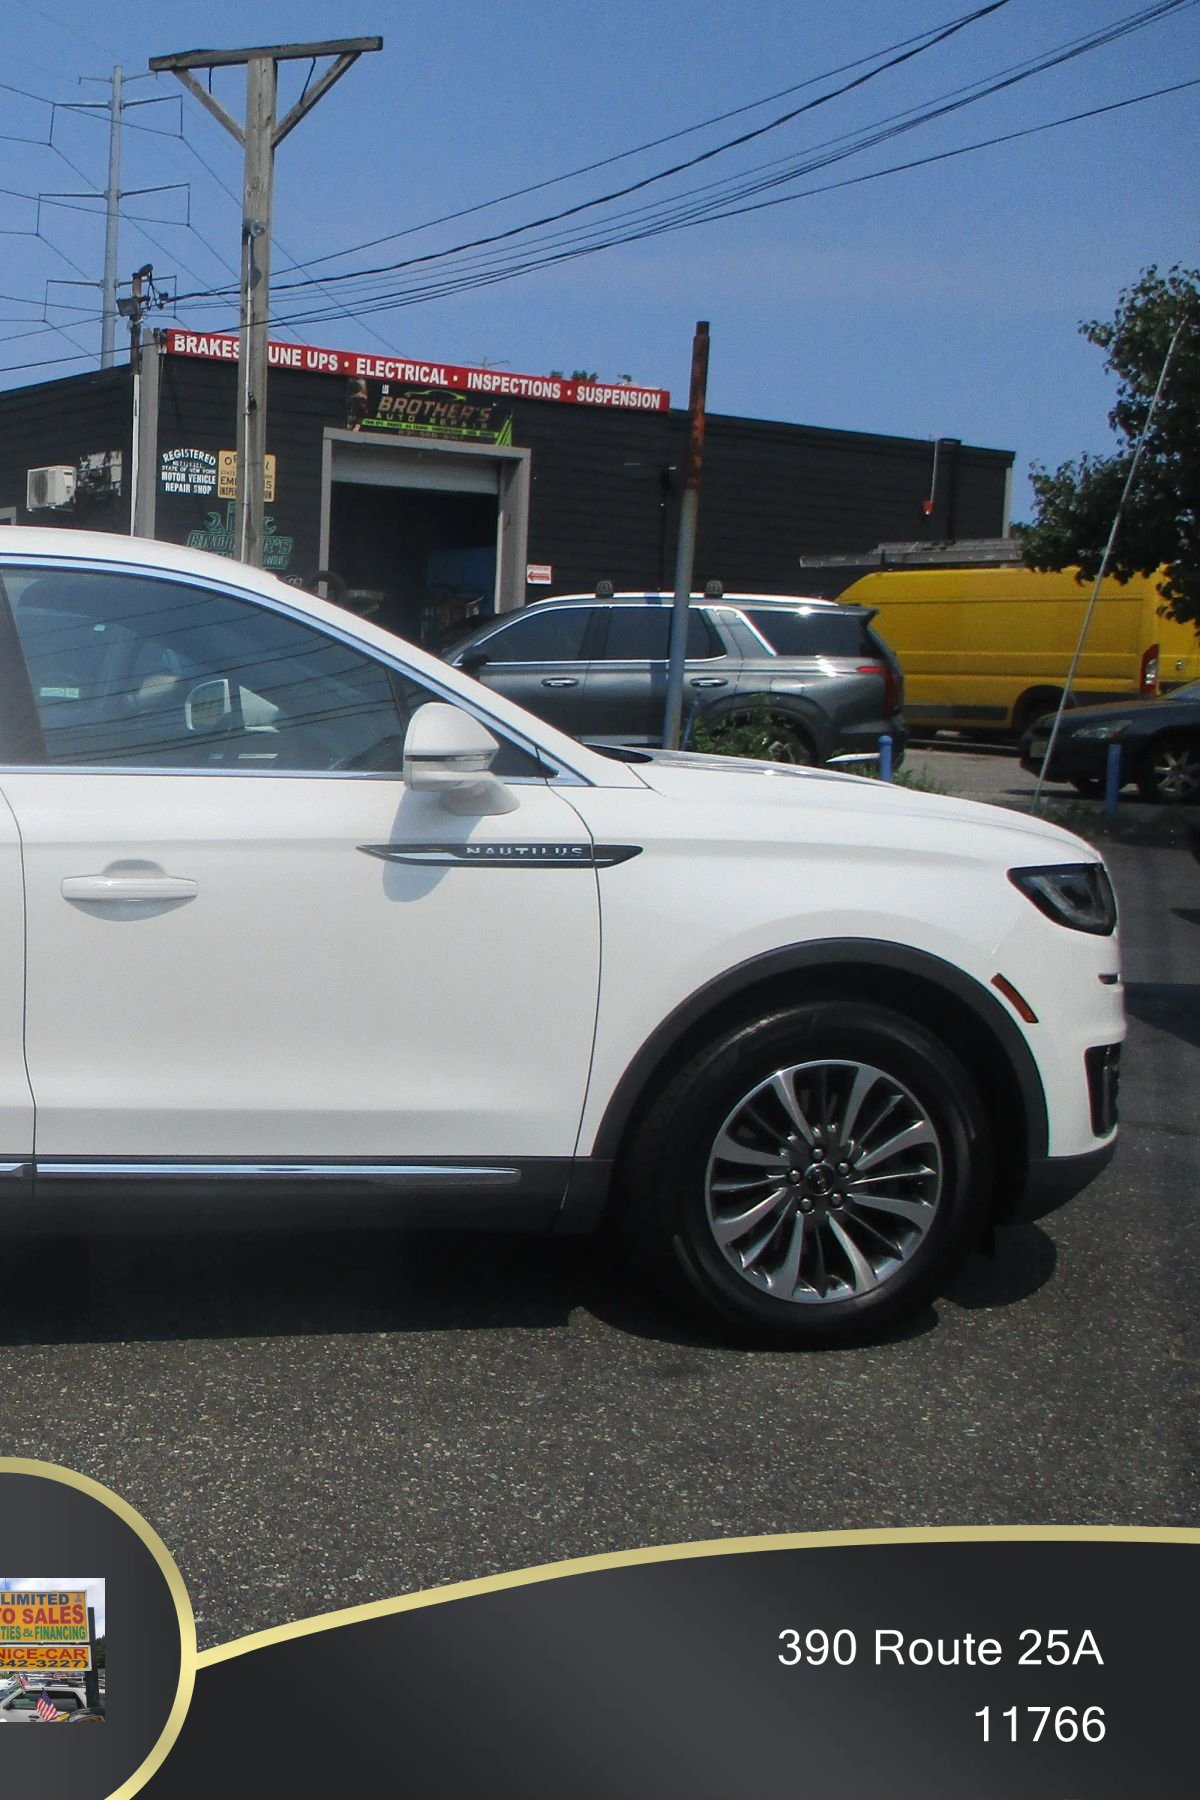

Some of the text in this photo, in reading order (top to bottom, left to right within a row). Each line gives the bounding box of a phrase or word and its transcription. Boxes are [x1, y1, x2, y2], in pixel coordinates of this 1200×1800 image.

[174, 334, 661, 409] BRAKES UNE UPS ELECTRICAL INSPECTIONS SUSPENSION
[378, 396, 492, 422] BROTHER'S
[375, 411, 416, 422] AUTO
[429, 417, 489, 430] REPAIR
[162, 448, 216, 466] REGISTERED
[161, 471, 186, 482] MOTOR
[188, 473, 216, 485] VEHICLE
[165, 482, 212, 495] REPAIR SHOP
[466, 846, 583, 856] NAUTILUS
